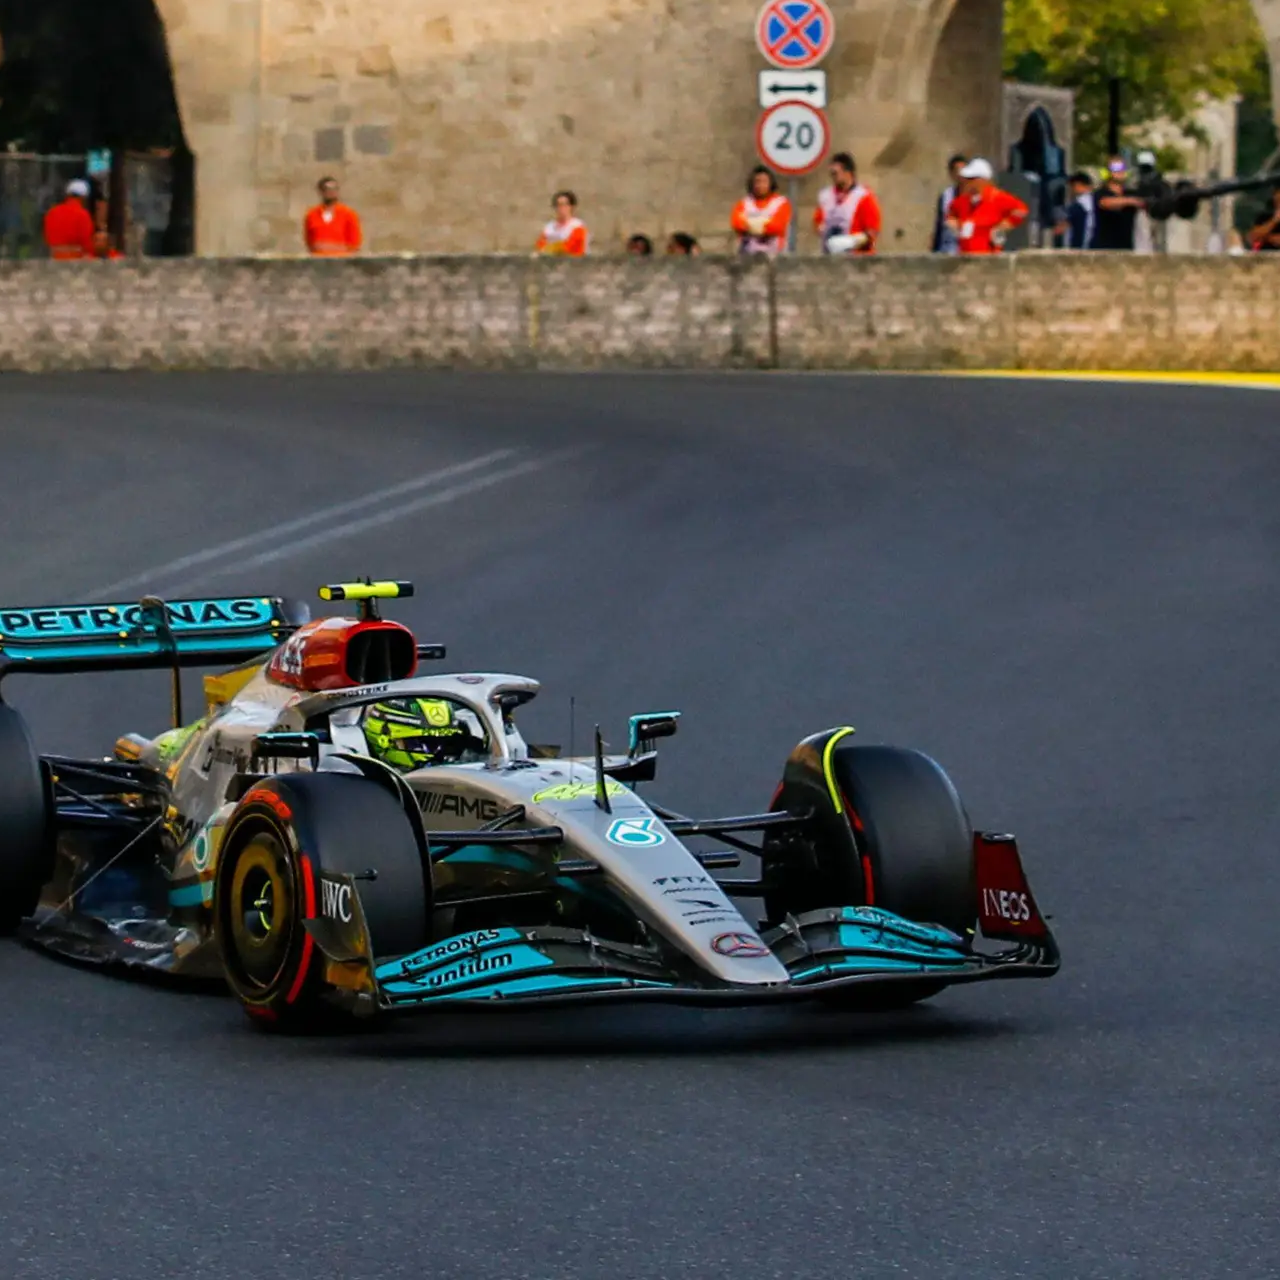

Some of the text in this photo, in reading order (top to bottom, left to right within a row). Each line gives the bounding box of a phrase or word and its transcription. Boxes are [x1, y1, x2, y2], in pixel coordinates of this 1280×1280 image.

[775, 121, 814, 151] 20
[439, 793, 499, 821] AMG
[321, 878, 353, 923] IWC
[982, 888, 1030, 921] INEOS
[400, 928, 501, 974] PETRONAS
